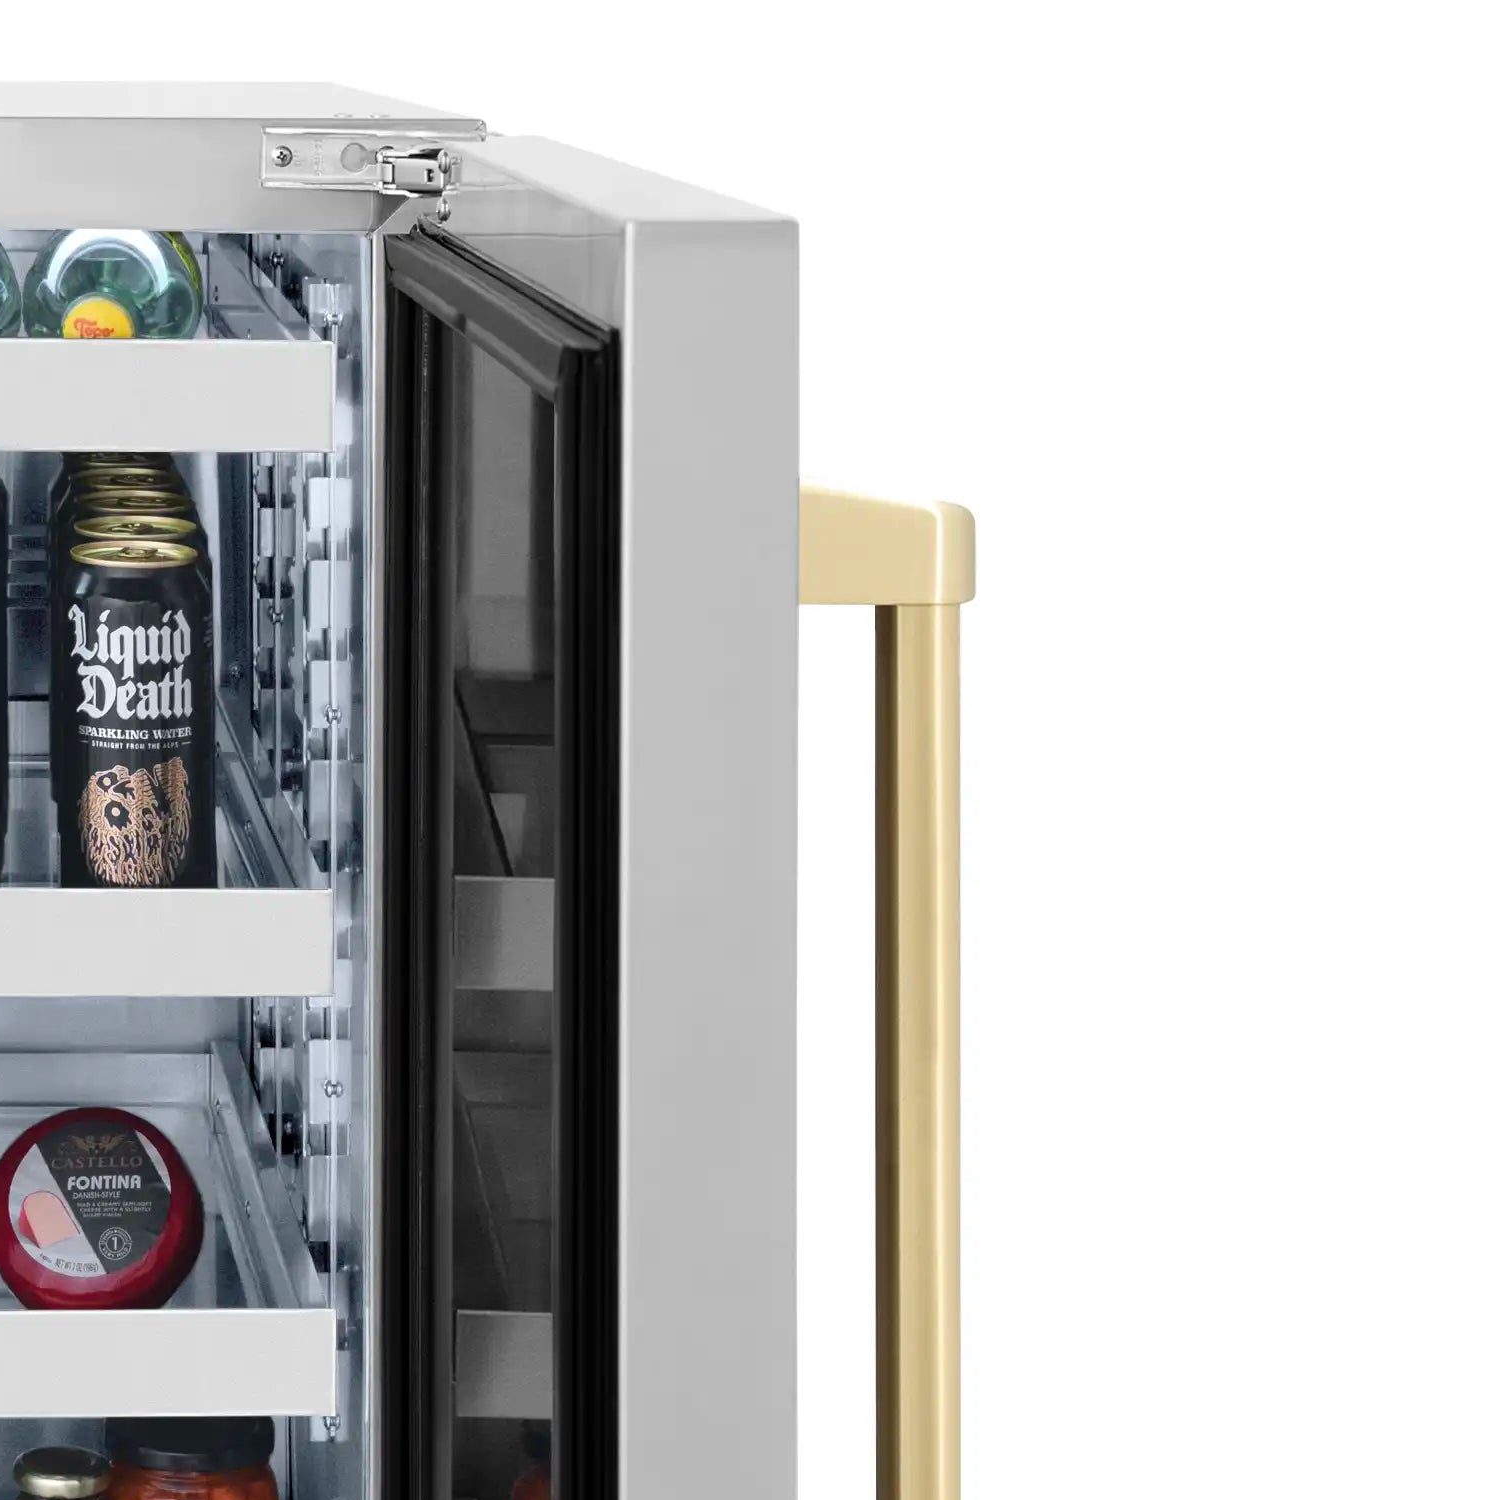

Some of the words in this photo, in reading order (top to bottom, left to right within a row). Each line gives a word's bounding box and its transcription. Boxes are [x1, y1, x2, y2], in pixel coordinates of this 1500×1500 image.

[68, 603, 191, 680] Liquid
[76, 661, 193, 720] Death
[78, 725, 149, 740] SPARKLING
[152, 726, 192, 740] WATER
[91, 740, 123, 750] STRAIGHT
[126, 742, 145, 750] FROM
[148, 742, 160, 750] THE
[162, 741, 179, 749] ALPS
[51, 1156, 143, 1169] CASTELLO
[67, 1175, 141, 1191] FONTINA
[73, 1191, 121, 1199] DANISH-STYLE
[111, 1236, 118, 1250] 1
